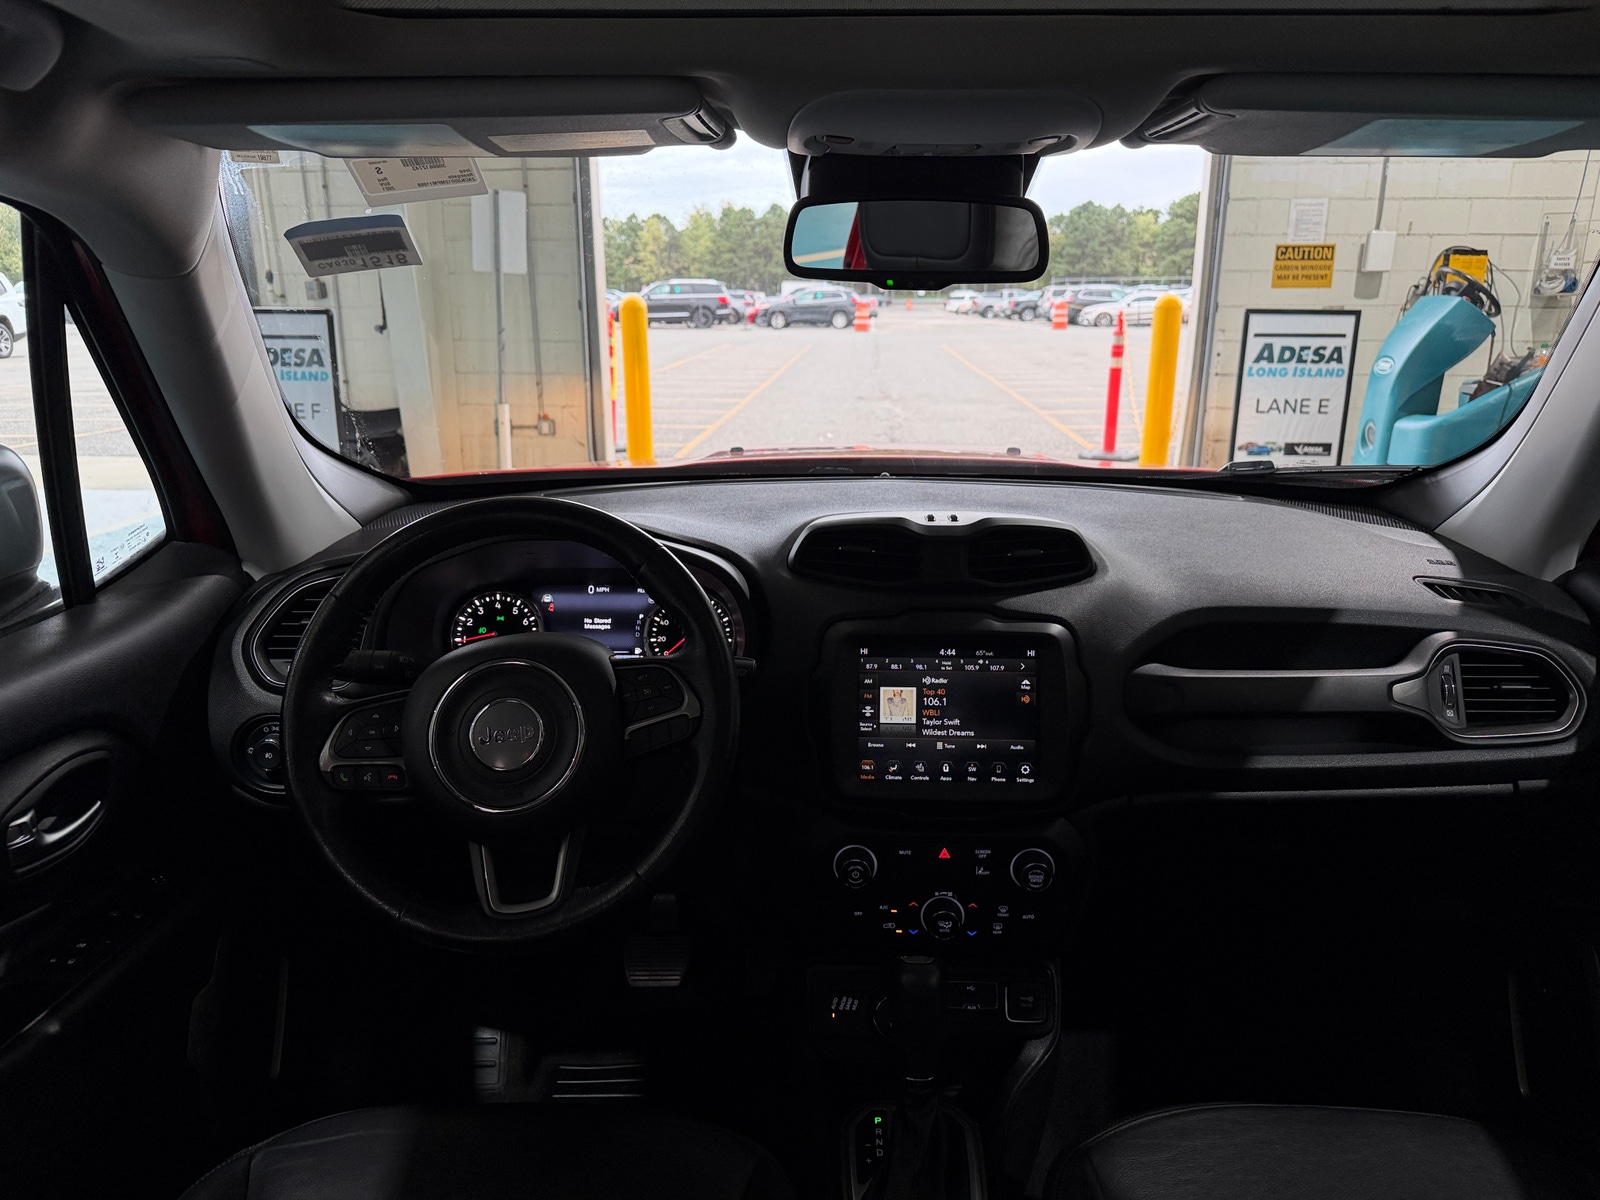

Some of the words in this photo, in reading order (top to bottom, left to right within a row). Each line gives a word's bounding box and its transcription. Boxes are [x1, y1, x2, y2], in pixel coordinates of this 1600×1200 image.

[1277, 246, 1333, 260] CAUTION
[1275, 263, 1299, 271] CARBON
[1300, 263, 1332, 271] MONOXIDE
[267, 347, 325, 367] DESA
[1252, 343, 1344, 364] ADESA
[280, 369, 329, 380] ISLAND
[1247, 366, 1289, 378] LONG
[1292, 366, 1345, 378] ISLAND
[1256, 398, 1311, 414] LANE
[1317, 398, 1330, 414] E
[587, 585, 595, 594] 0
[495, 601, 501, 609] 4
[477, 606, 484, 615] 3
[512, 606, 519, 615] 5
[466, 618, 473, 626] 2
[522, 618, 529, 626] 6
[939, 648, 956, 656] 4:44
[922, 688, 935, 696] Top
[922, 697, 947, 706] 106.1
[922, 718, 942, 727] Taylor
[943, 718, 961, 726] Swift
[478, 725, 535, 746] Jeep
[874, 1116, 882, 1125] P
[875, 1128, 883, 1136] R
[875, 1138, 883, 1146] N
[876, 1148, 884, 1157] D
